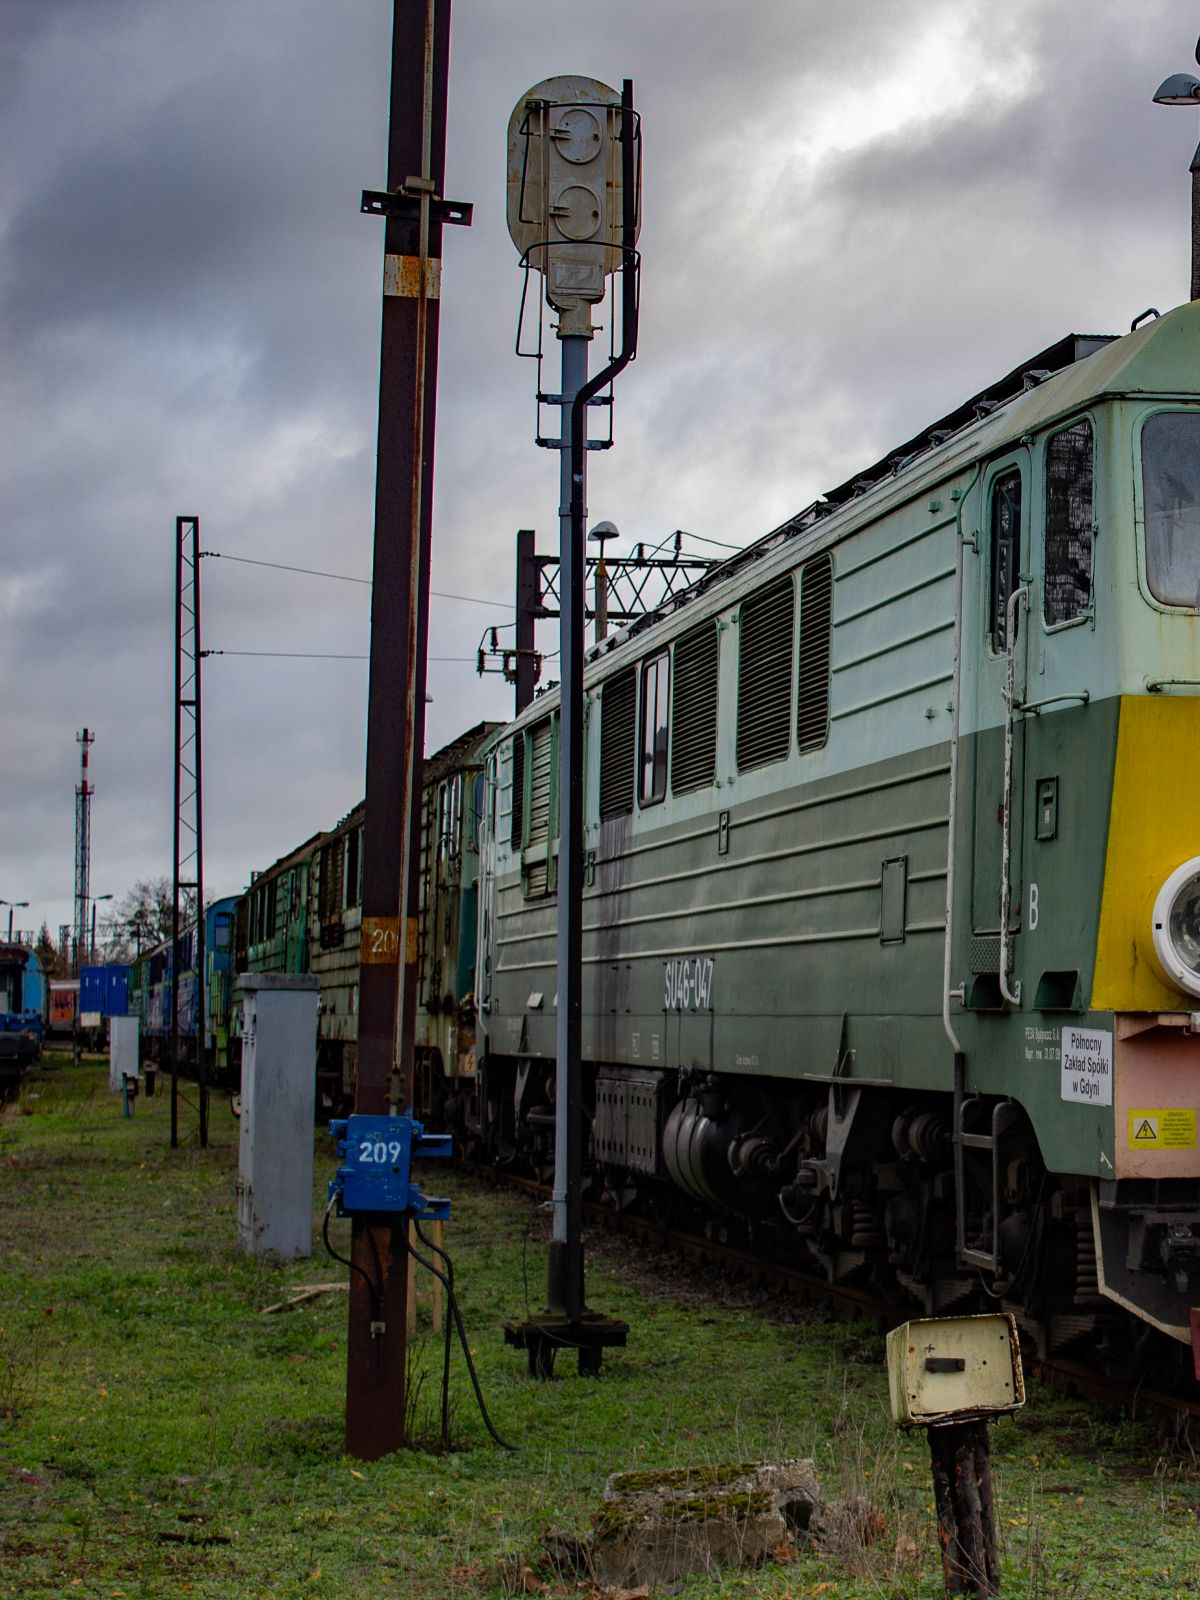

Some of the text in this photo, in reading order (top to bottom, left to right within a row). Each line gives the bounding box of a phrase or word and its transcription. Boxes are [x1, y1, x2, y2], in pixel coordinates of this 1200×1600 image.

[1029, 883, 1039, 931] B
[371, 928, 400, 953] 20
[665, 958, 714, 1009] SU46-047
[1071, 1032, 1102, 1056] Północny
[1064, 1054, 1109, 1076] Zakład Spółki
[1073, 1078, 1100, 1099] w Gdyni
[359, 1141, 402, 1164] 209
